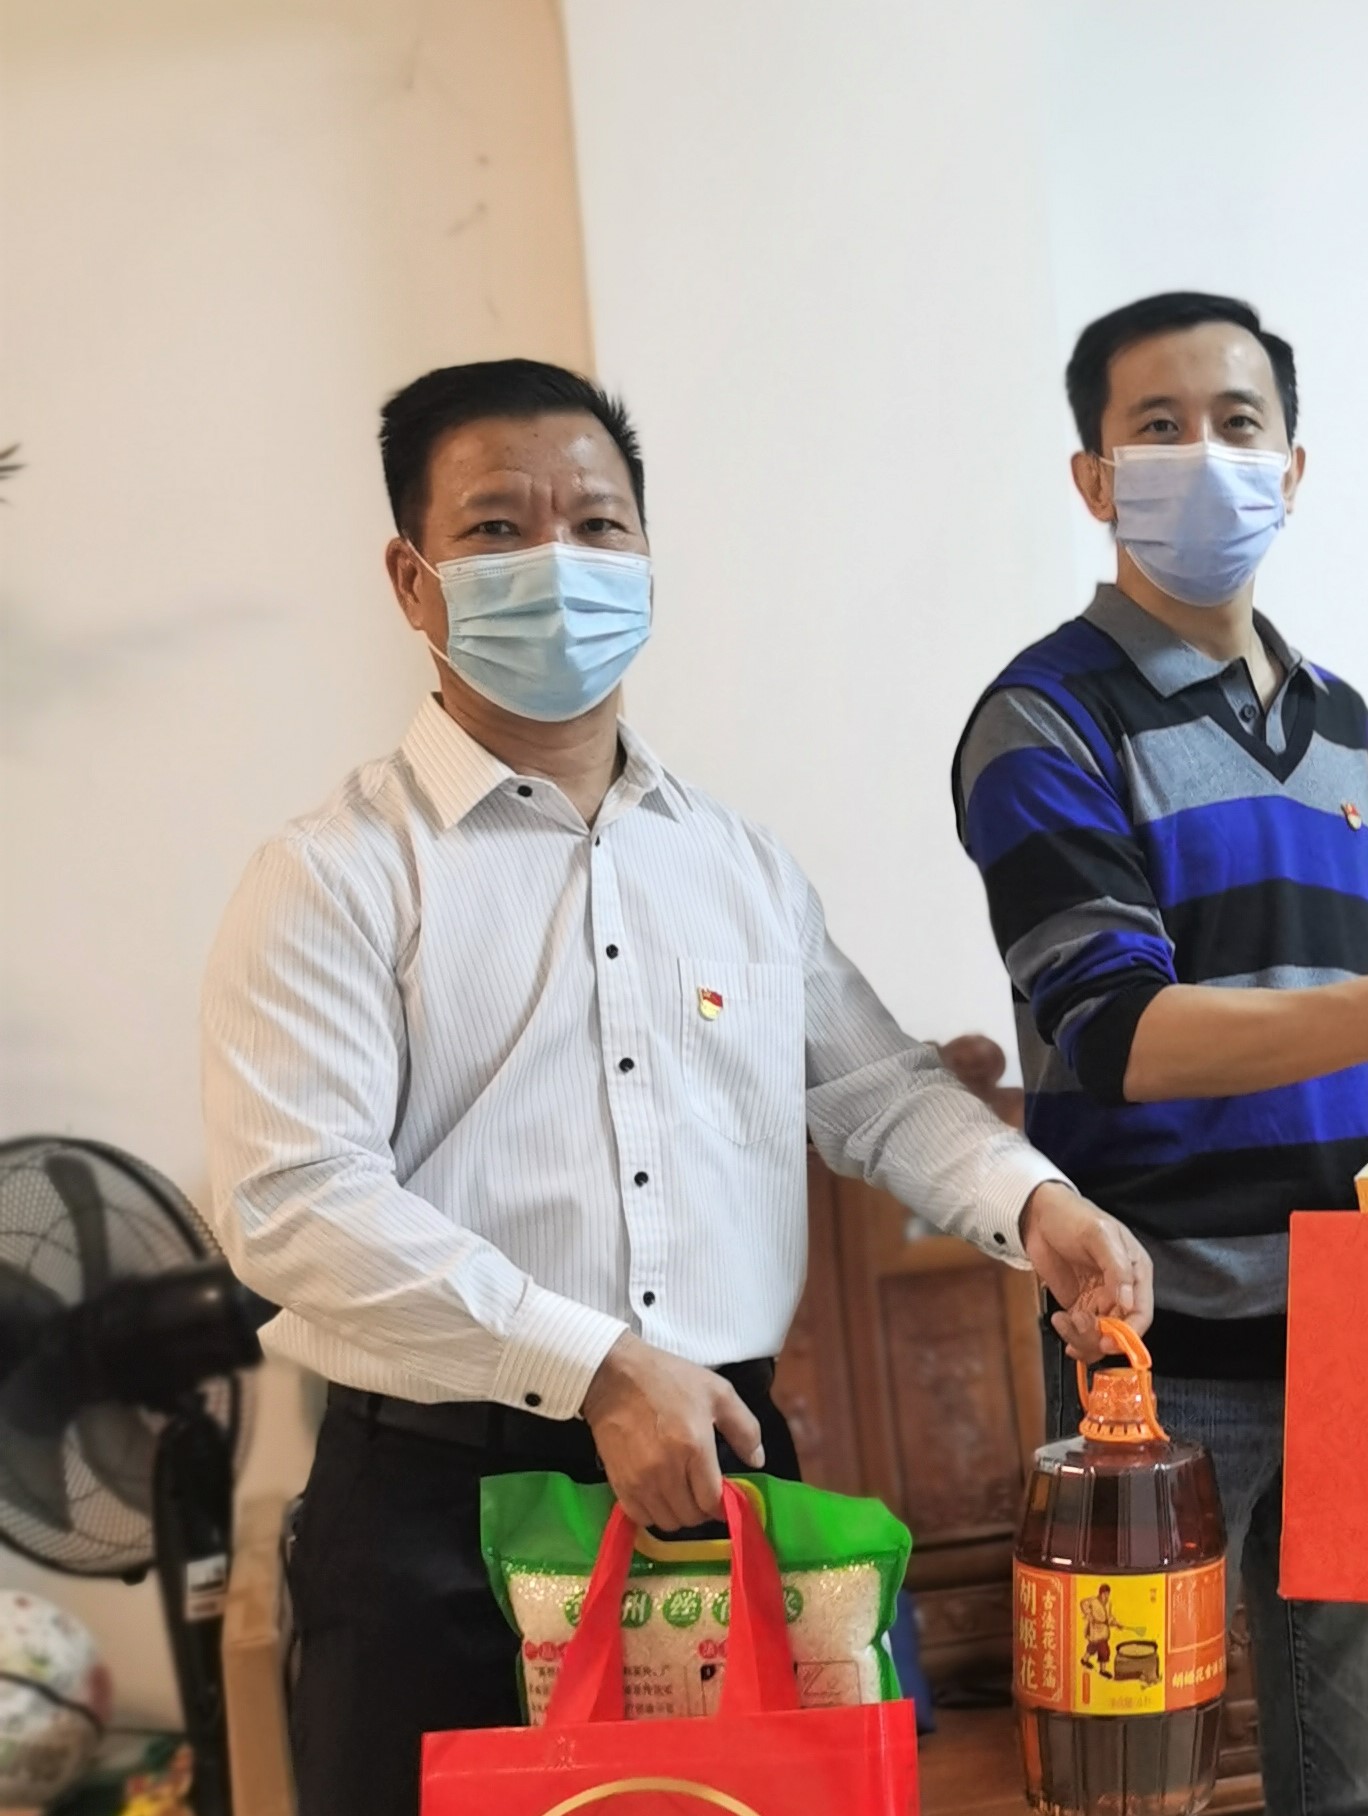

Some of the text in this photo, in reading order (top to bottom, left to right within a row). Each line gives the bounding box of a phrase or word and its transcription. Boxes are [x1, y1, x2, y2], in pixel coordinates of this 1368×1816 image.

[1020, 1577, 1039, 1690] 胡姬花
[1042, 1589, 1058, 1689] 古法花生油
